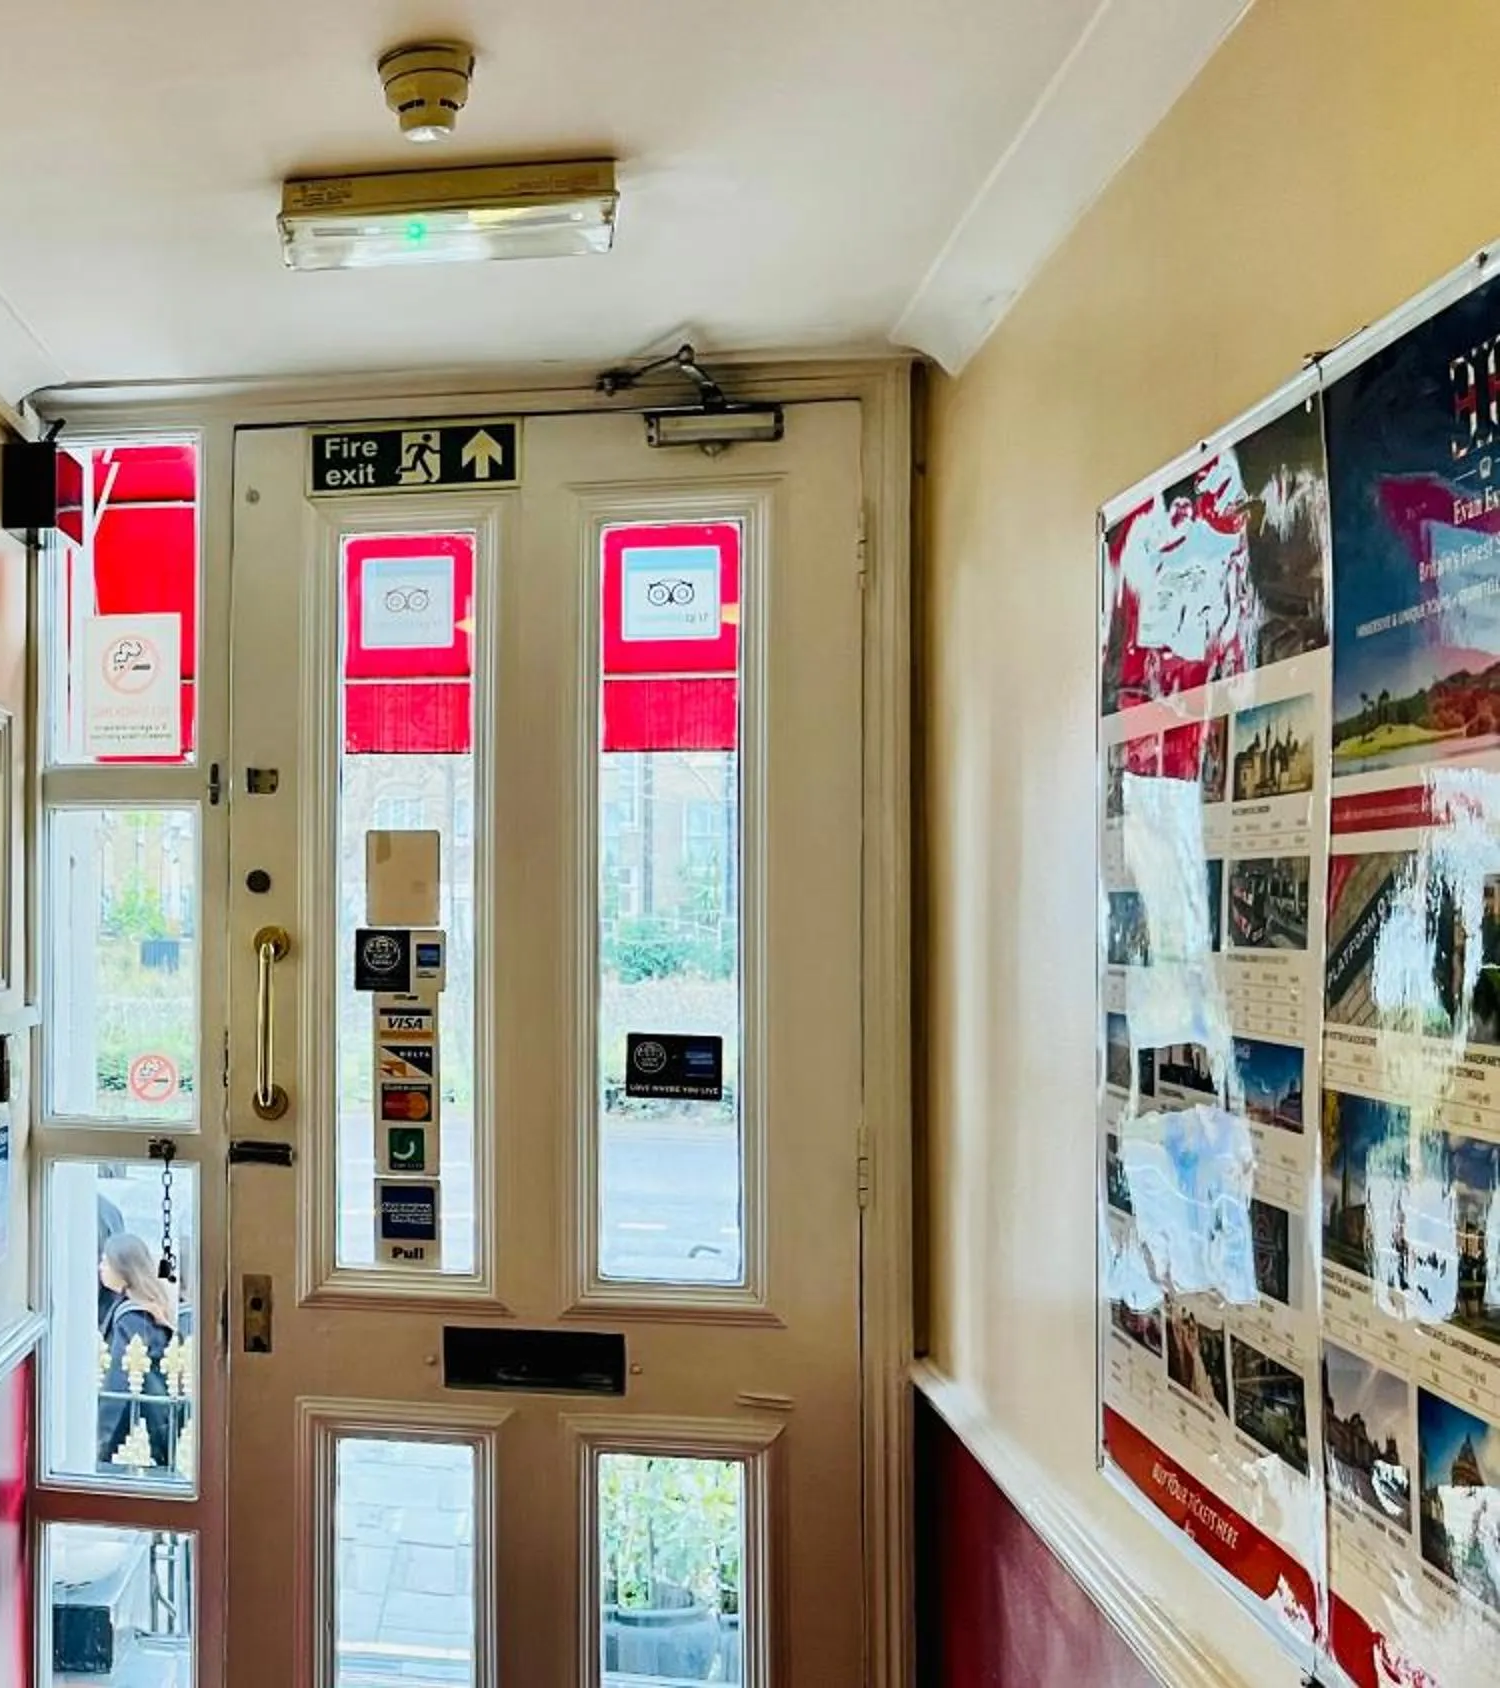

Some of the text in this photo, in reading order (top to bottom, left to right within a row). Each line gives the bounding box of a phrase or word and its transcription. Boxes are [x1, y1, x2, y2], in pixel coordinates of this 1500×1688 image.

[325, 437, 378, 459] Fire
[325, 463, 375, 486] exit
[1327, 915, 1377, 989] PLATFORM
[387, 1018, 424, 1029] VISA
[391, 1246, 424, 1260] Pull
